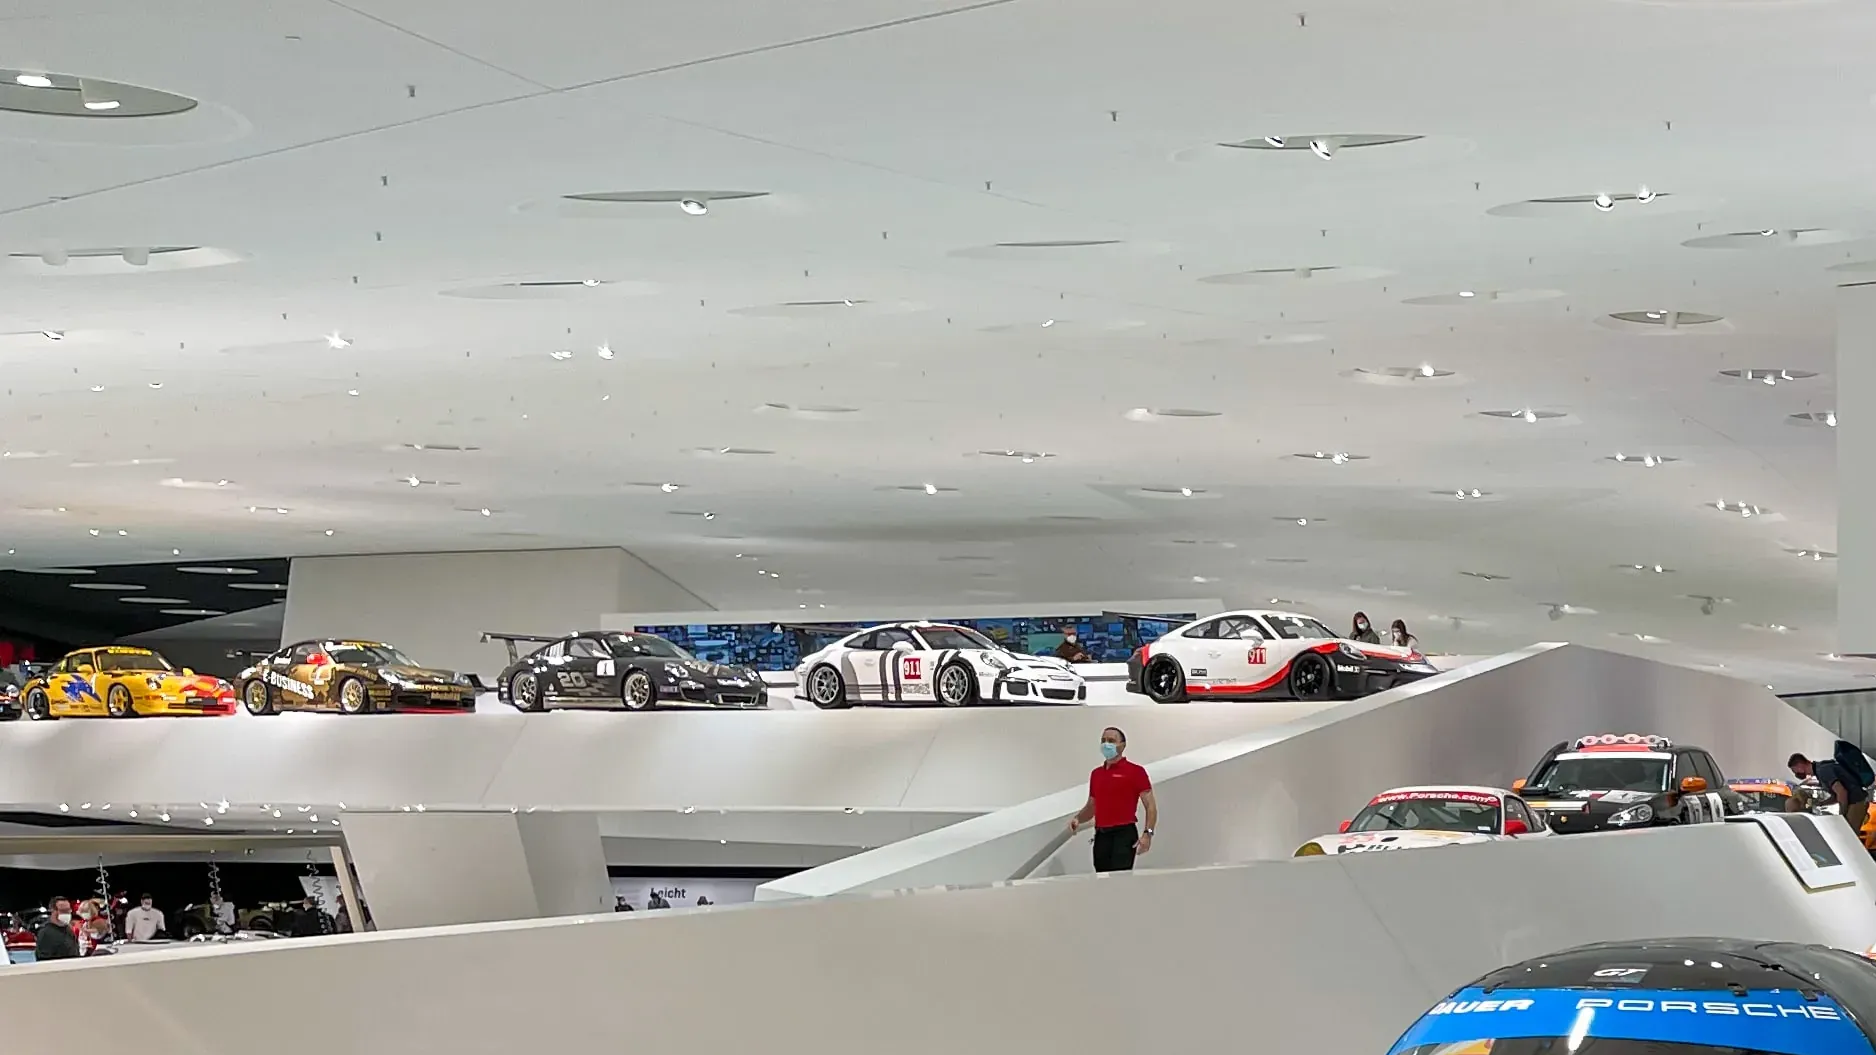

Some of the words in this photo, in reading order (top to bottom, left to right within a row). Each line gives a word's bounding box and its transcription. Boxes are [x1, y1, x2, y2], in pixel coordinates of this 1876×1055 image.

[1250, 648, 1267, 664] 911
[903, 660, 921, 676] 911
[263, 669, 315, 700] E-BUSINESS
[1593, 967, 1648, 980] GT
[1431, 999, 1535, 1017] DAUER
[1575, 998, 1842, 1021] PORSCHE
